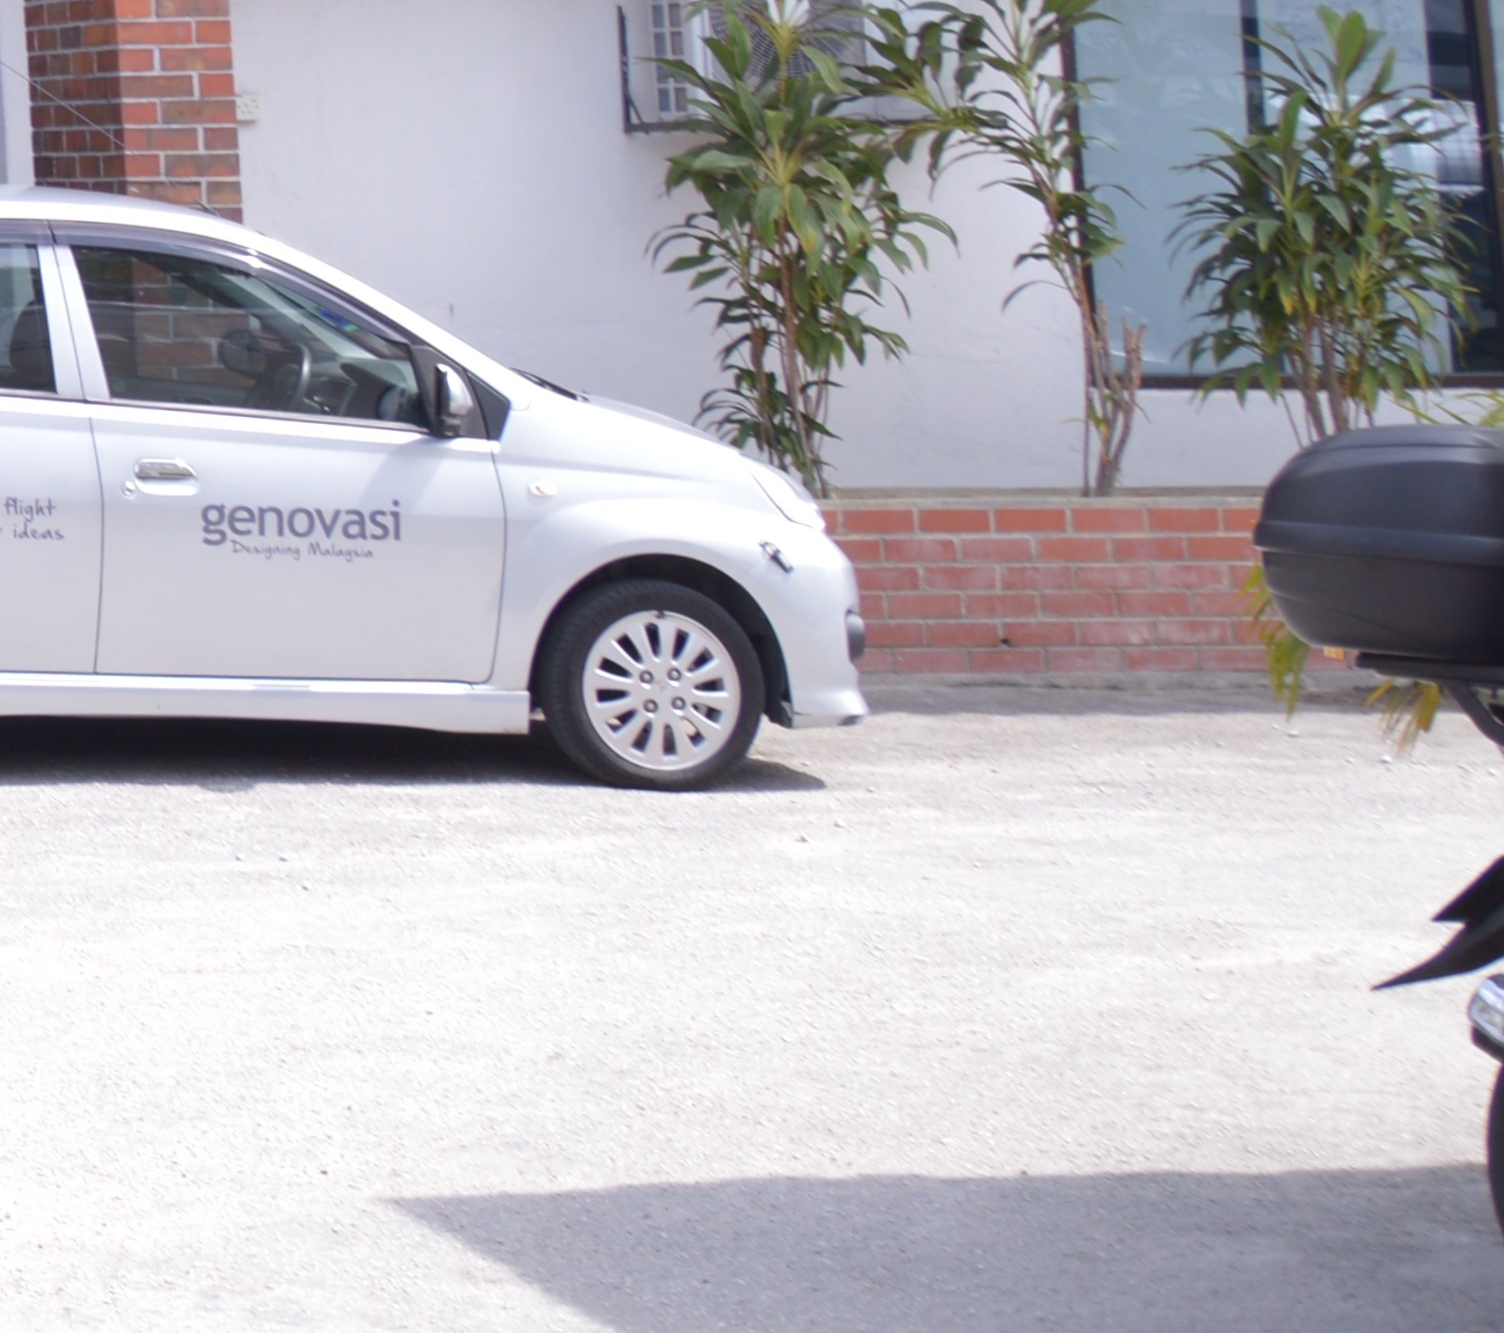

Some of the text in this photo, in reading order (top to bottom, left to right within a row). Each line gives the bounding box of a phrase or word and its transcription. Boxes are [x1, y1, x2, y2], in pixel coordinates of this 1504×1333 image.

[3, 495, 57, 523] flight
[13, 521, 65, 541] ideas
[200, 499, 402, 546] genovasi
[229, 539, 375, 563] Designing Malaysia
